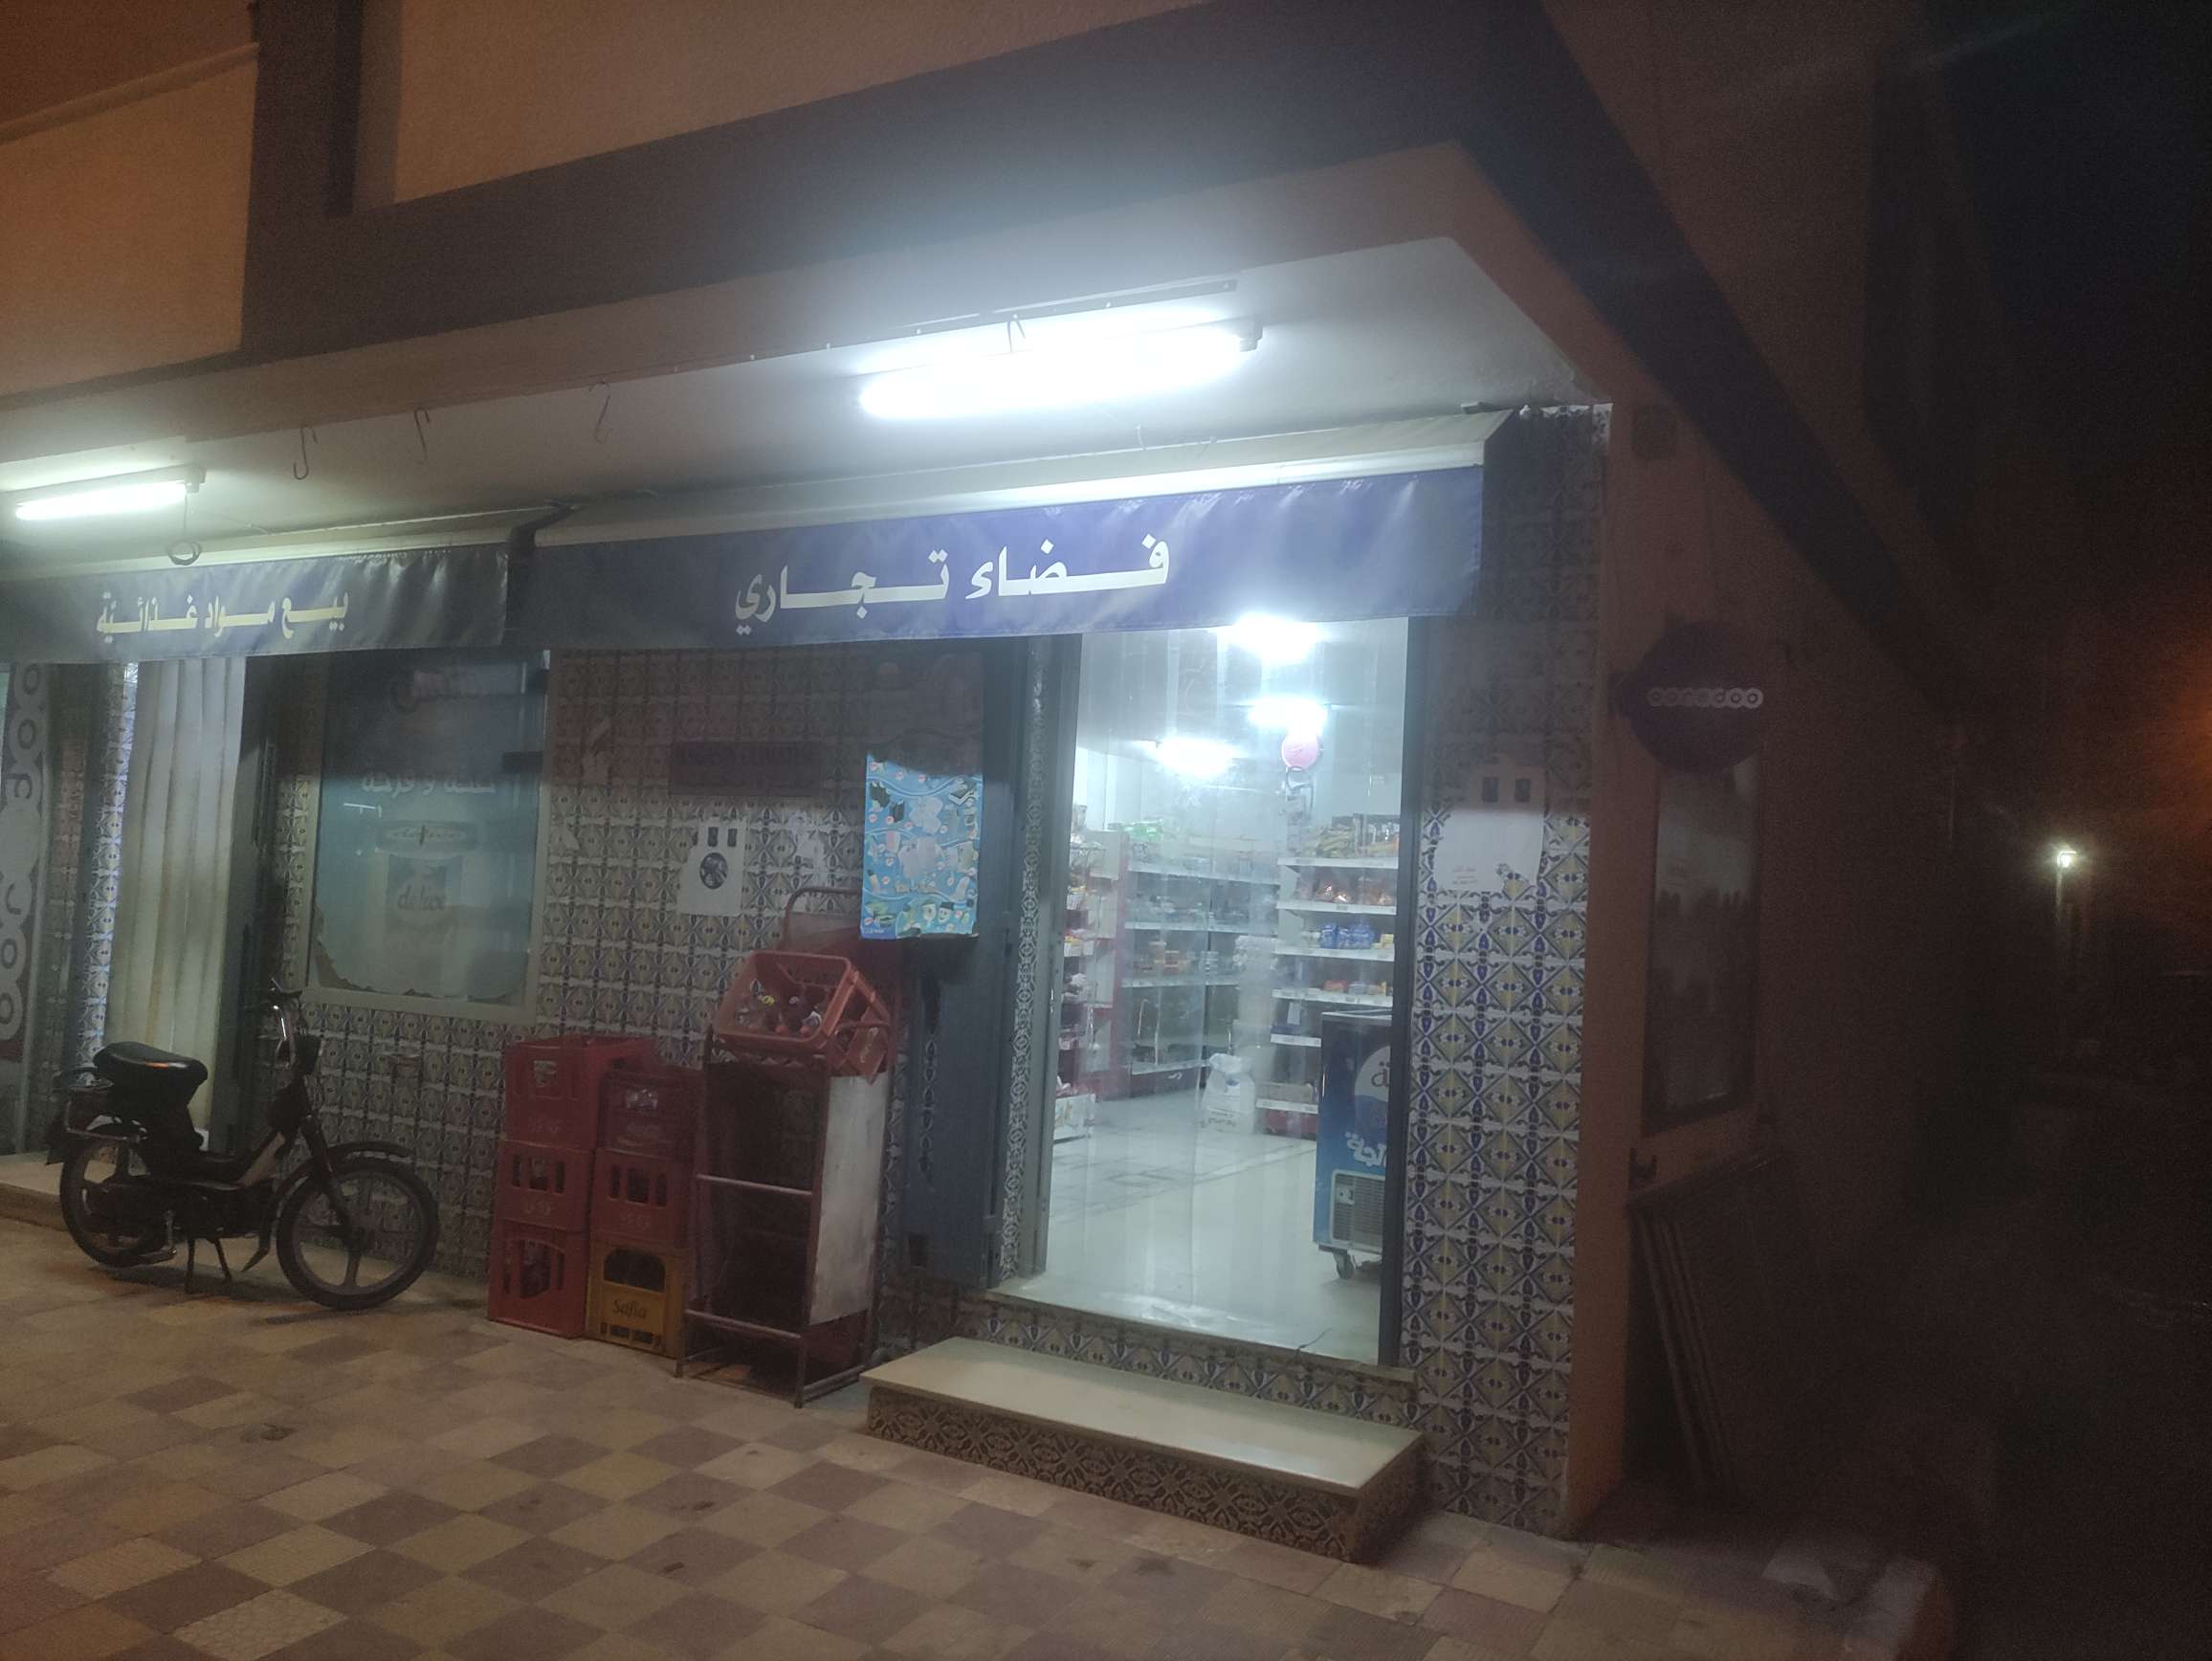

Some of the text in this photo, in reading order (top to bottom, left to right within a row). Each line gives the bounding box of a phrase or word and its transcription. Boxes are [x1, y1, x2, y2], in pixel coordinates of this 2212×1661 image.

[97, 591, 349, 644] بيع مواد غذائية
[735, 533, 1169, 635] فضاء تجاري
[0, 662, 46, 1035] oordoo
